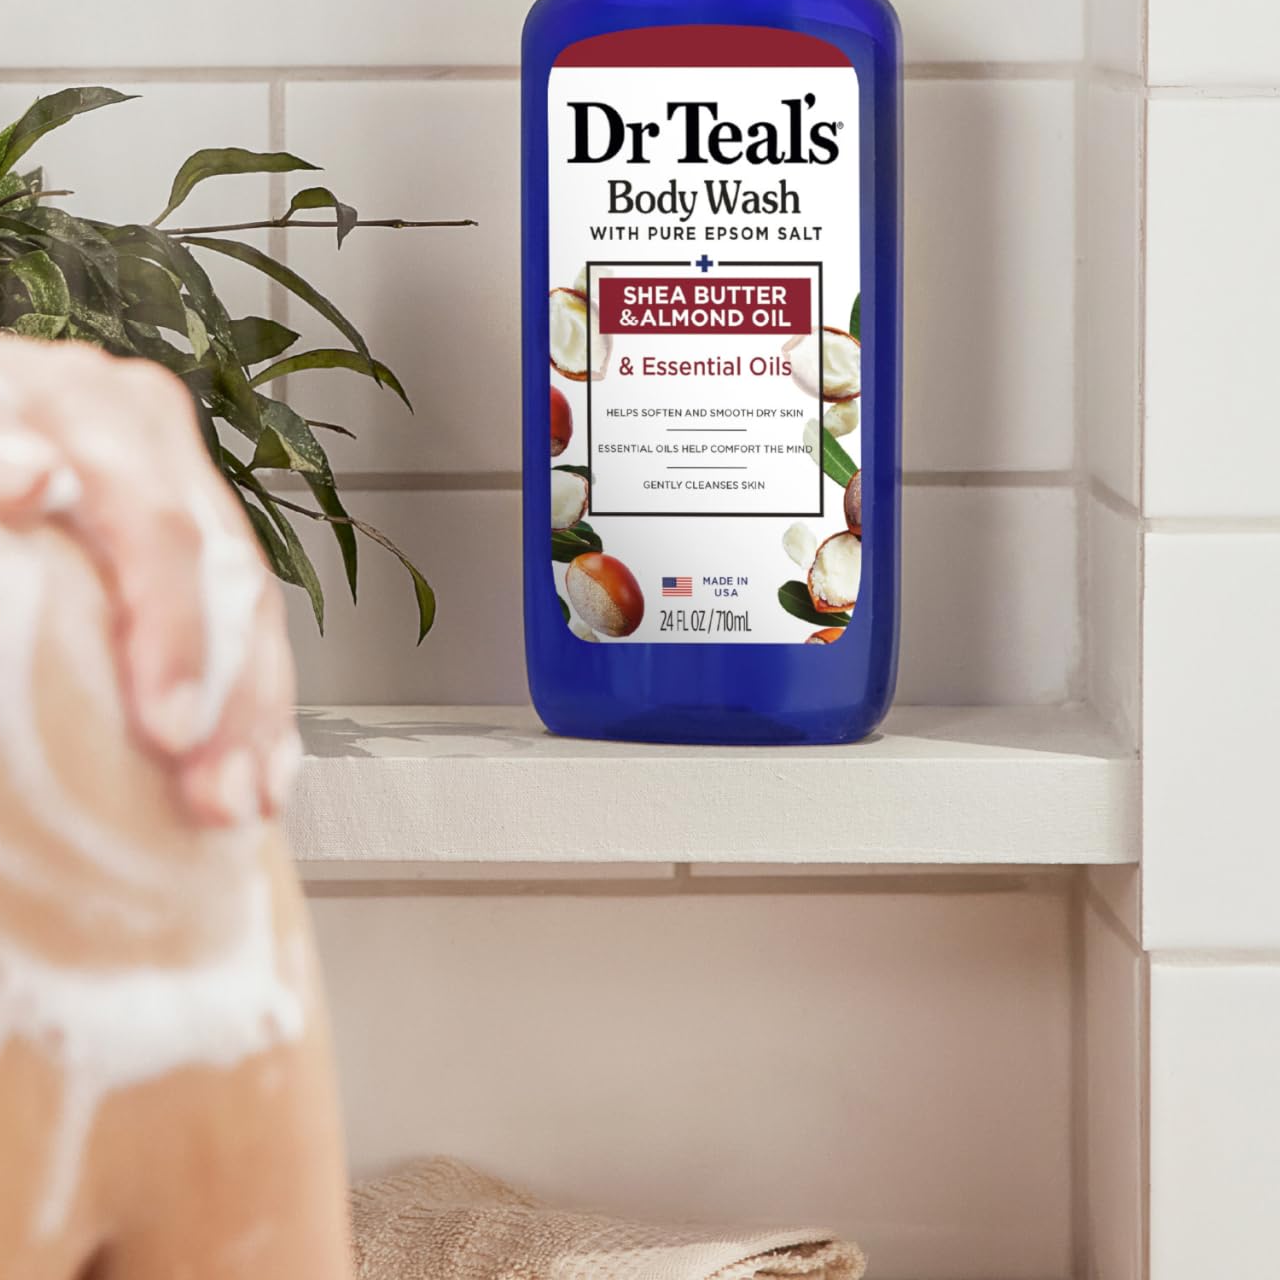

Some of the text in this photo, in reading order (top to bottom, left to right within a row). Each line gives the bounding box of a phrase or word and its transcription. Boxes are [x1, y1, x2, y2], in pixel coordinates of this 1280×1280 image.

[567, 102, 660, 164] Dr
[608, 178, 801, 222] Body Wash
[590, 226, 822, 240] WITH PURE EPSOM SALT
[623, 285, 787, 305] SHEA BUTTER
[752, 309, 791, 327] OIL
[619, 357, 792, 376] & Essential Oils
[606, 409, 803, 418] HELPS SOFTEN AND SMOOTH DRY SKIN
[598, 444, 813, 454] ESSENTIAL OILS HELP COMFORT THE MIND
[643, 481, 765, 490] GENTLY CLEANSES SKIN
[703, 577, 748, 585] MADE IN
[714, 588, 738, 596] USA
[660, 611, 674, 632] 24
[676, 611, 689, 632] FL
